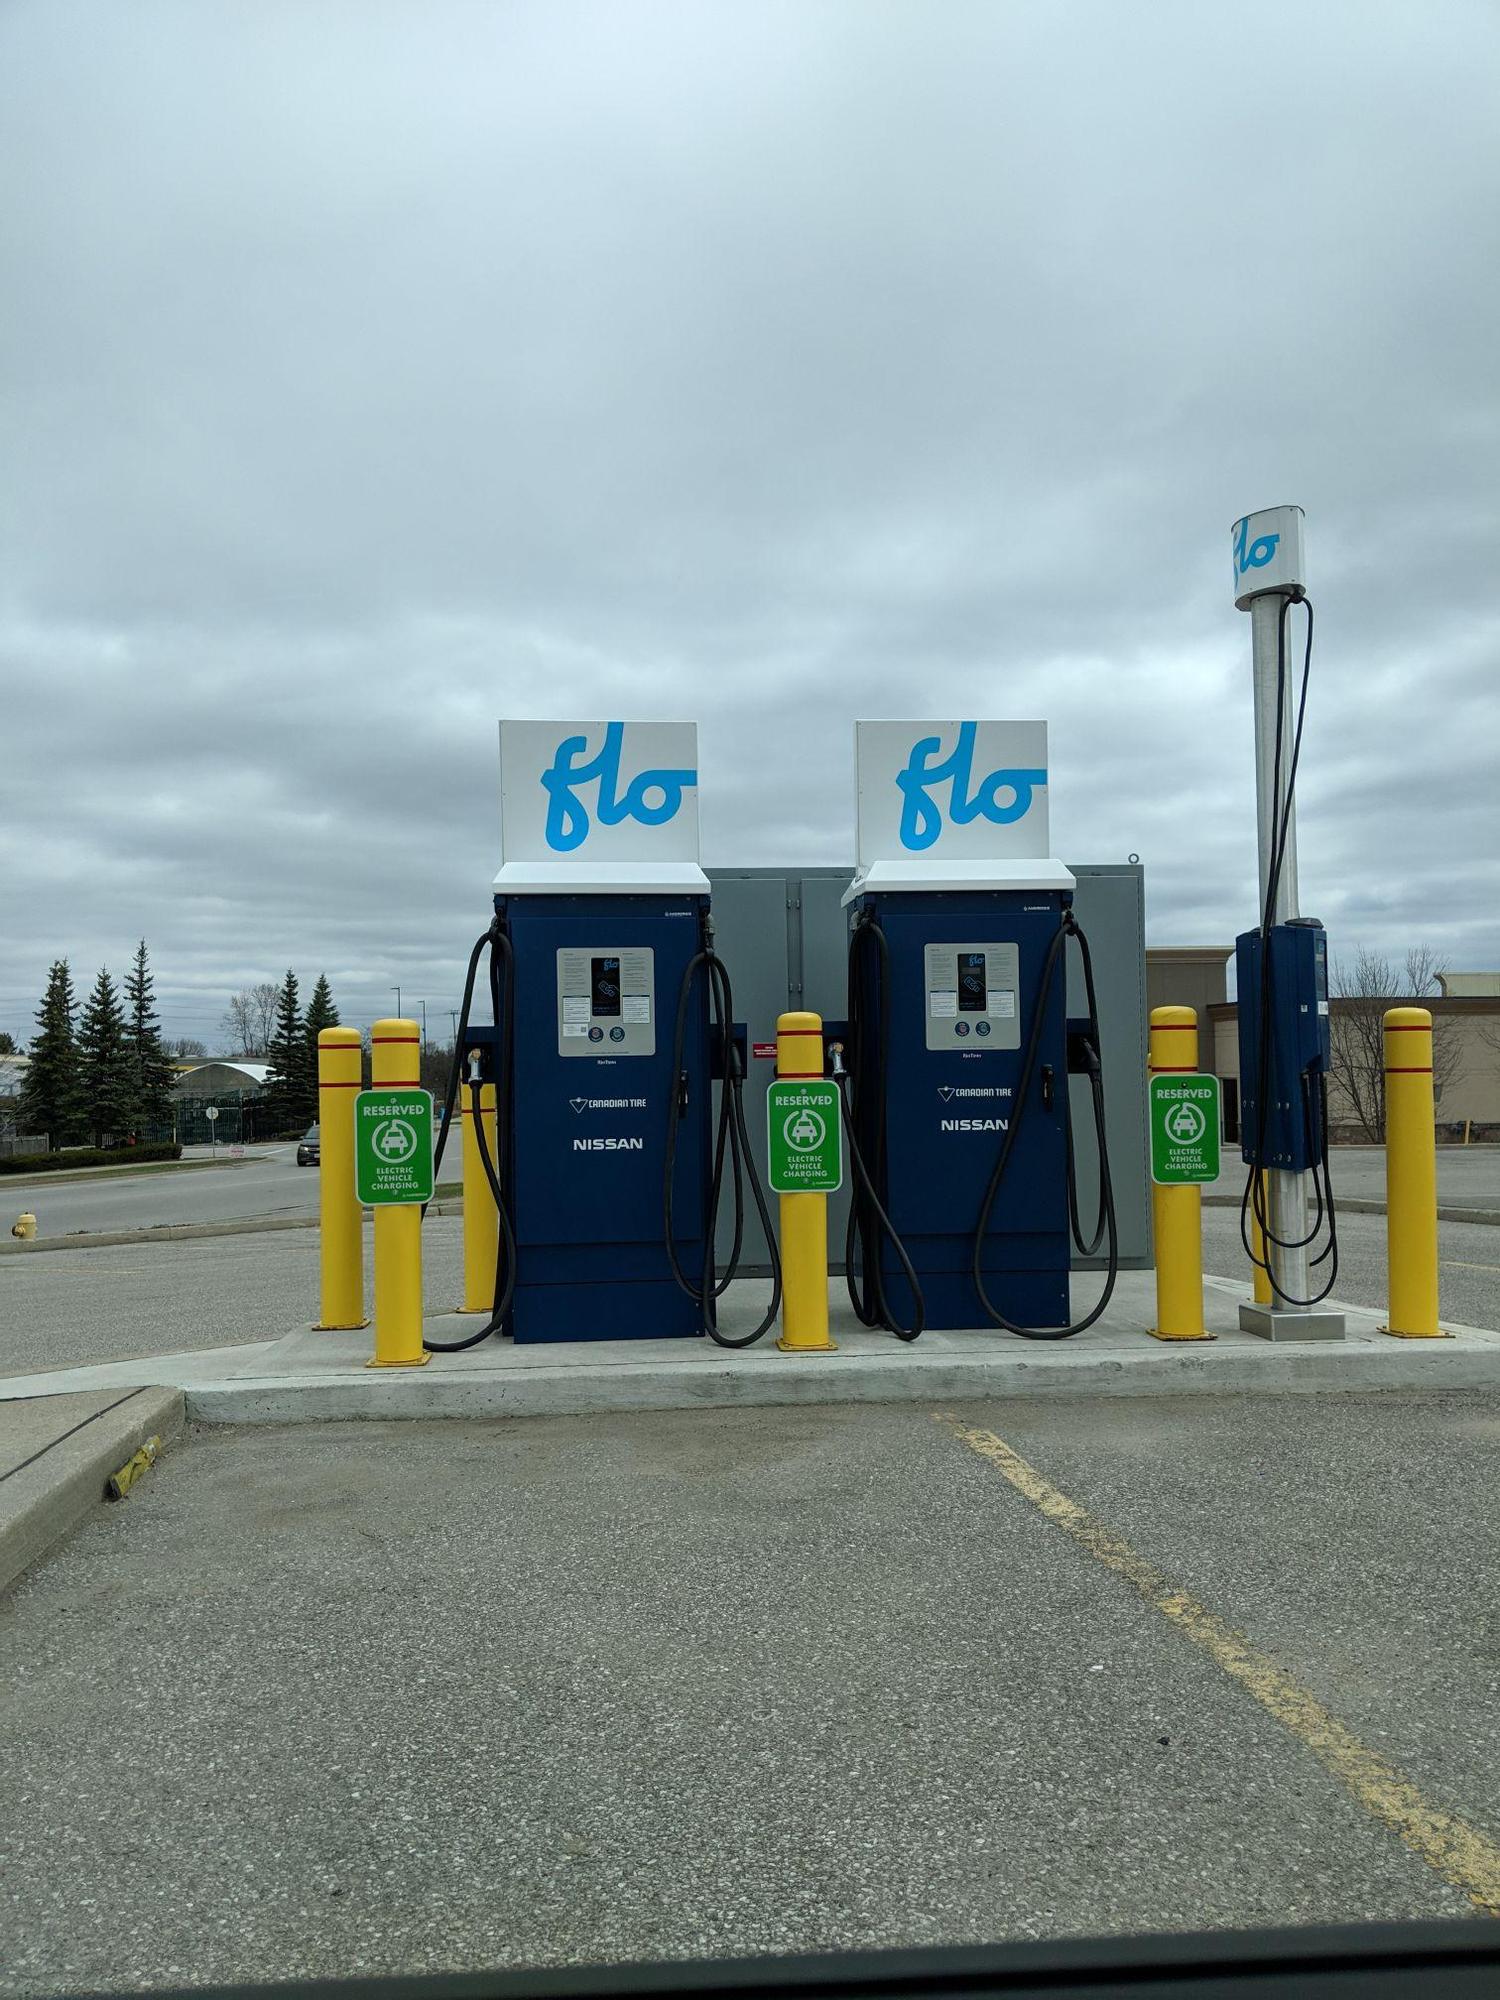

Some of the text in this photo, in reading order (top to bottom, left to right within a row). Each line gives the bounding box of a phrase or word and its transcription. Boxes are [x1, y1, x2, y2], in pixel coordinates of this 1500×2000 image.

[541, 721, 697, 852] flo
[896, 721, 1048, 852] flo
[955, 1088, 1012, 1097] CANADIAN TIRE
[1156, 1089, 1212, 1099] RESERVED
[588, 1098, 647, 1108] CANADIAN TIRE
[775, 1095, 832, 1106] RESERVED
[363, 1104, 425, 1116] RESERVED
[941, 1119, 1009, 1131] NISSAN
[573, 1137, 643, 1150] NISSAN
[376, 1166, 414, 1174] ELECTRIC
[1164, 1162, 1208, 1170] CHARGING
[378, 1174, 413, 1182] VEHICLE
[783, 1170, 828, 1178] CHARGING
[371, 1181, 419, 1190] CHARGING
